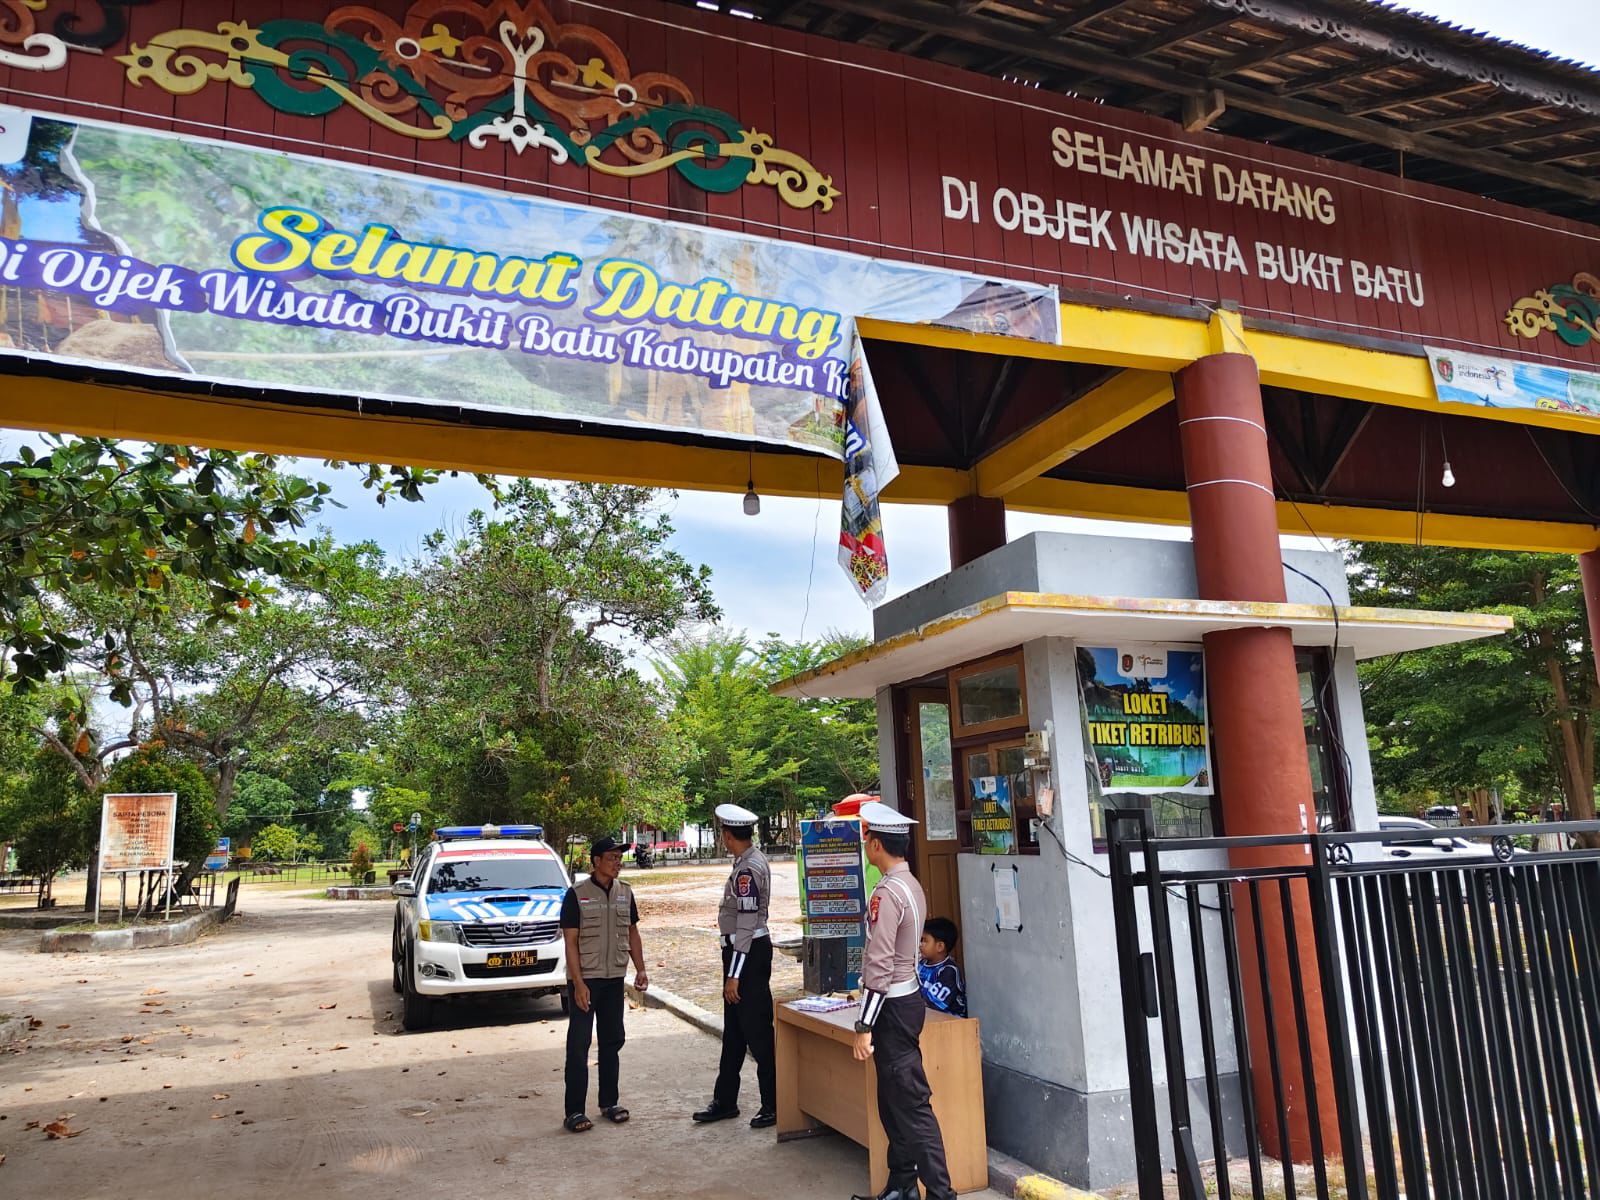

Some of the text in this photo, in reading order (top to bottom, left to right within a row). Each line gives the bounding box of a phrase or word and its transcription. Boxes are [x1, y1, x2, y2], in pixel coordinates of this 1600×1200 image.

[1051, 127, 1336, 225] SELAMAT DATANG
[235, 208, 841, 358] Selamat Datang
[941, 175, 1425, 308] DI OBJEK WISATA BUKIT BATU
[39, 248, 184, 307] Objek
[199, 272, 374, 330] Wisata
[386, 296, 507, 345] Bukit
[517, 314, 616, 360] Batu
[624, 329, 816, 387] Kabupaten
[1089, 722, 1127, 745] TIKET
[1122, 693, 1168, 715] LOKET
